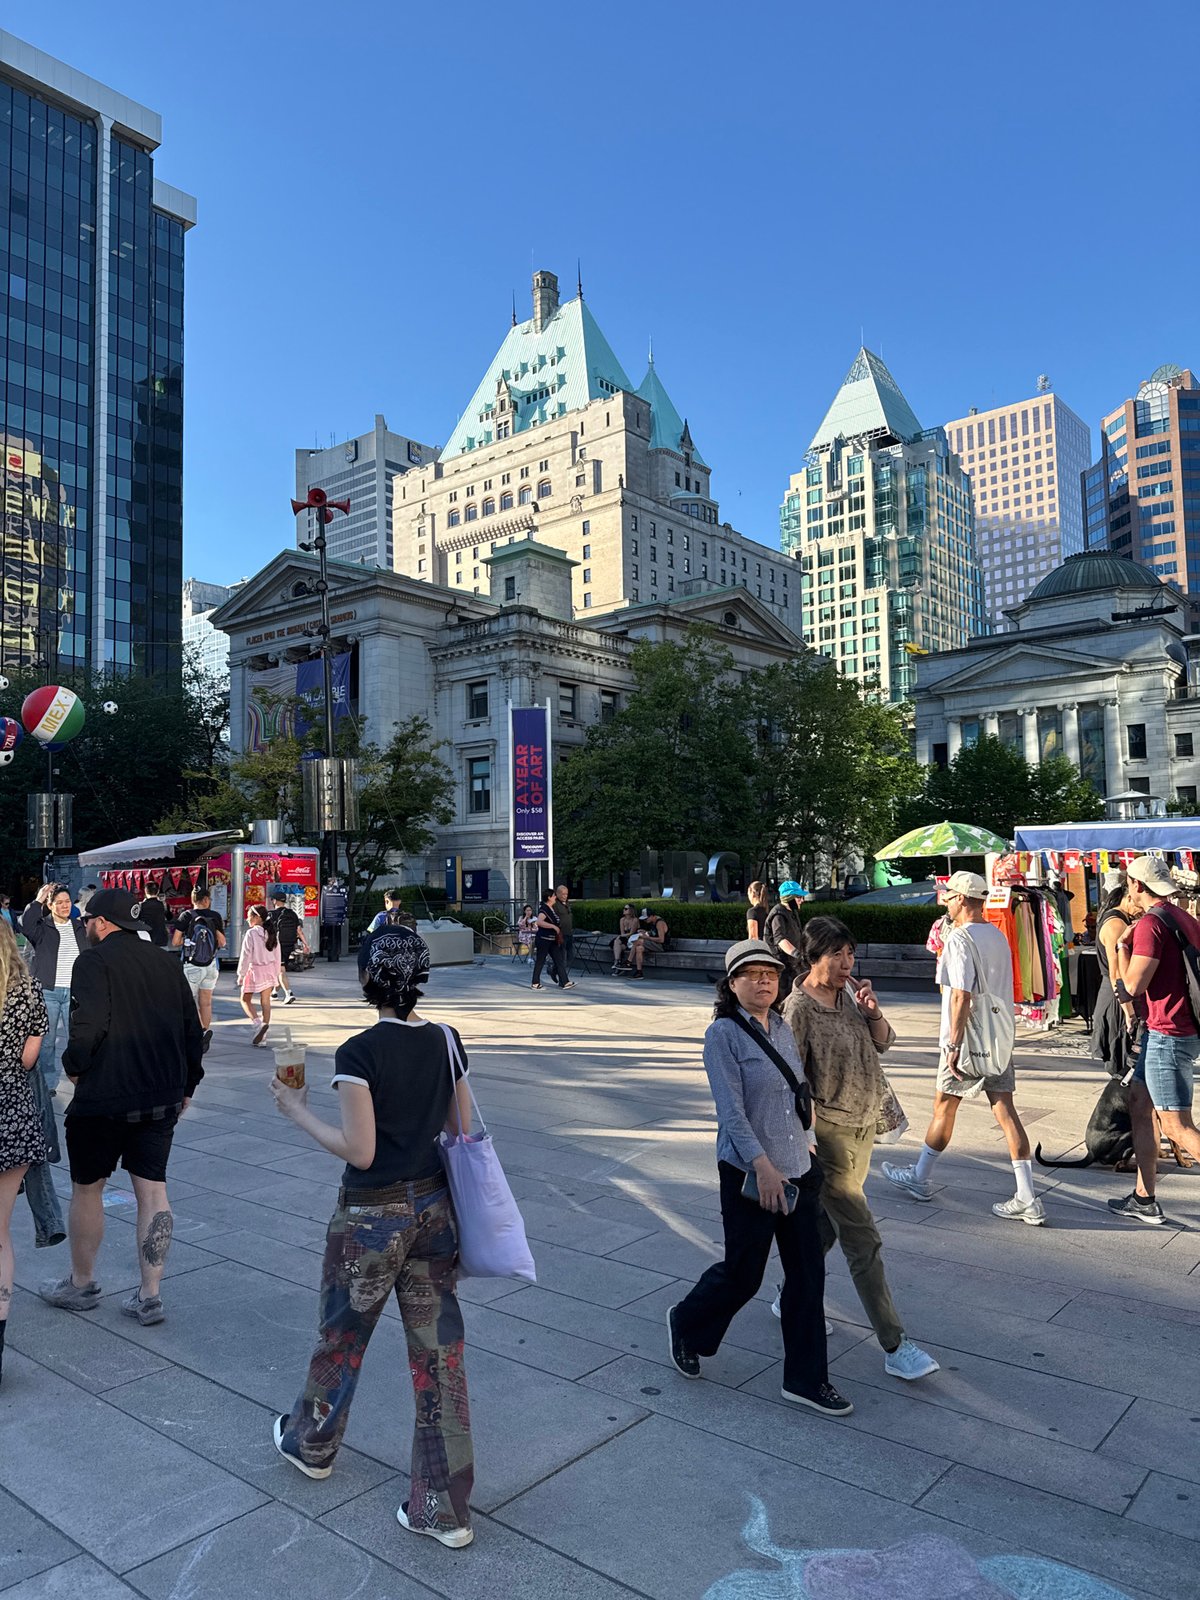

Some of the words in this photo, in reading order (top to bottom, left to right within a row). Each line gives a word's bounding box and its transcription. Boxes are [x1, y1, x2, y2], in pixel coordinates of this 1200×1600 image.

[41, 699, 70, 733] MEX
[516, 744, 529, 791] YEAR
[531, 745, 543, 779] ART
[516, 798, 529, 806] A
[531, 782, 543, 805] OF
[516, 807, 530, 815] Only
[640, 850, 741, 903] UBC
